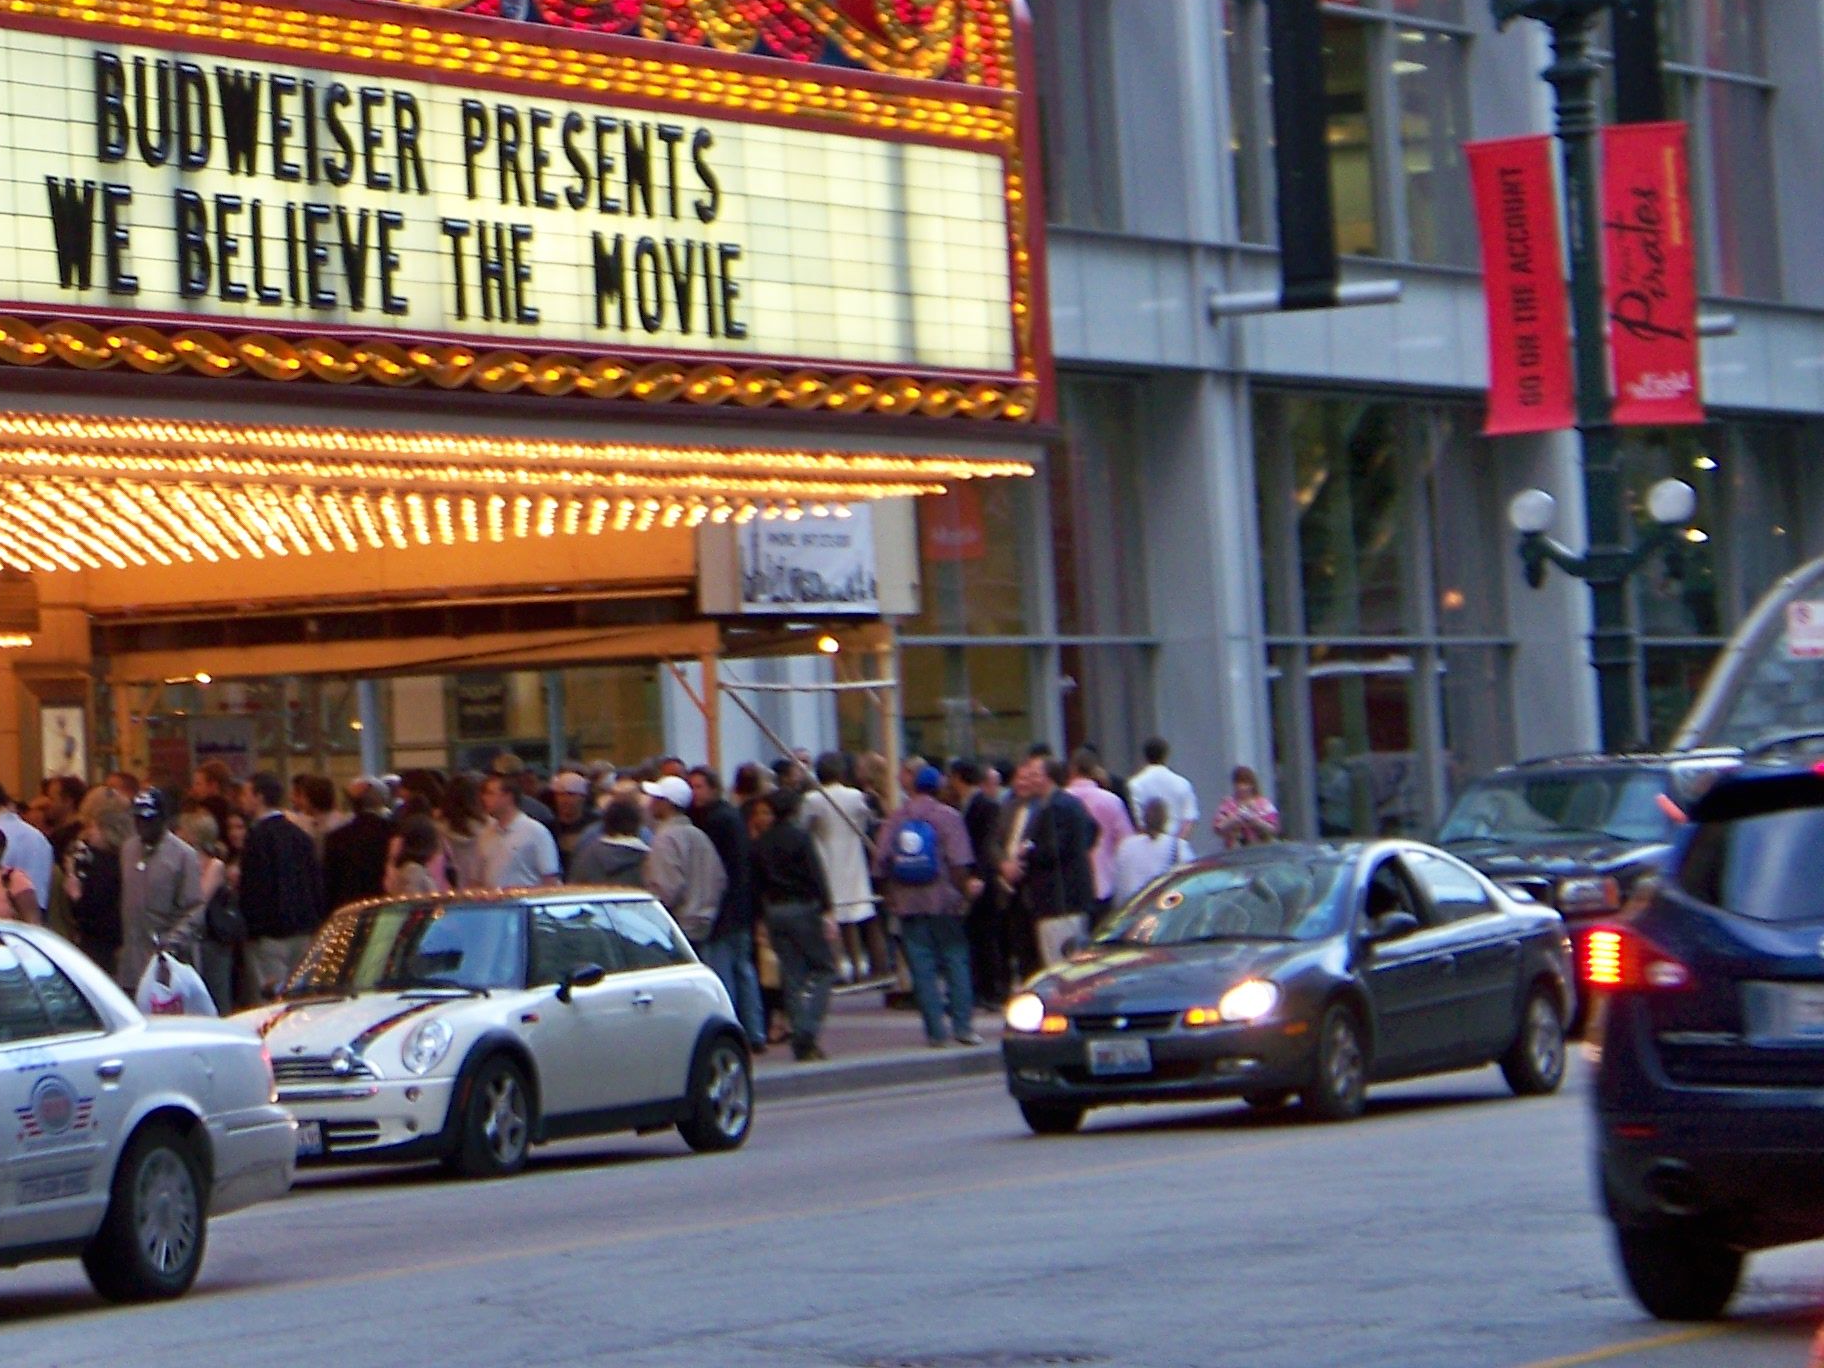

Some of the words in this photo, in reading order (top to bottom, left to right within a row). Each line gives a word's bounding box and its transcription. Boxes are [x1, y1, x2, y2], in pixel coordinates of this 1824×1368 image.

[94, 50, 429, 196] BUDWEISER
[461, 98, 721, 224] PRESENTS
[45, 175, 140, 296] WE
[176, 188, 409, 315] BELIEVE
[441, 216, 540, 325] THE
[592, 229, 749, 339] MOVIE
[1499, 167, 1532, 274] ACCOUNT
[1604, 186, 1687, 341] Pirates
